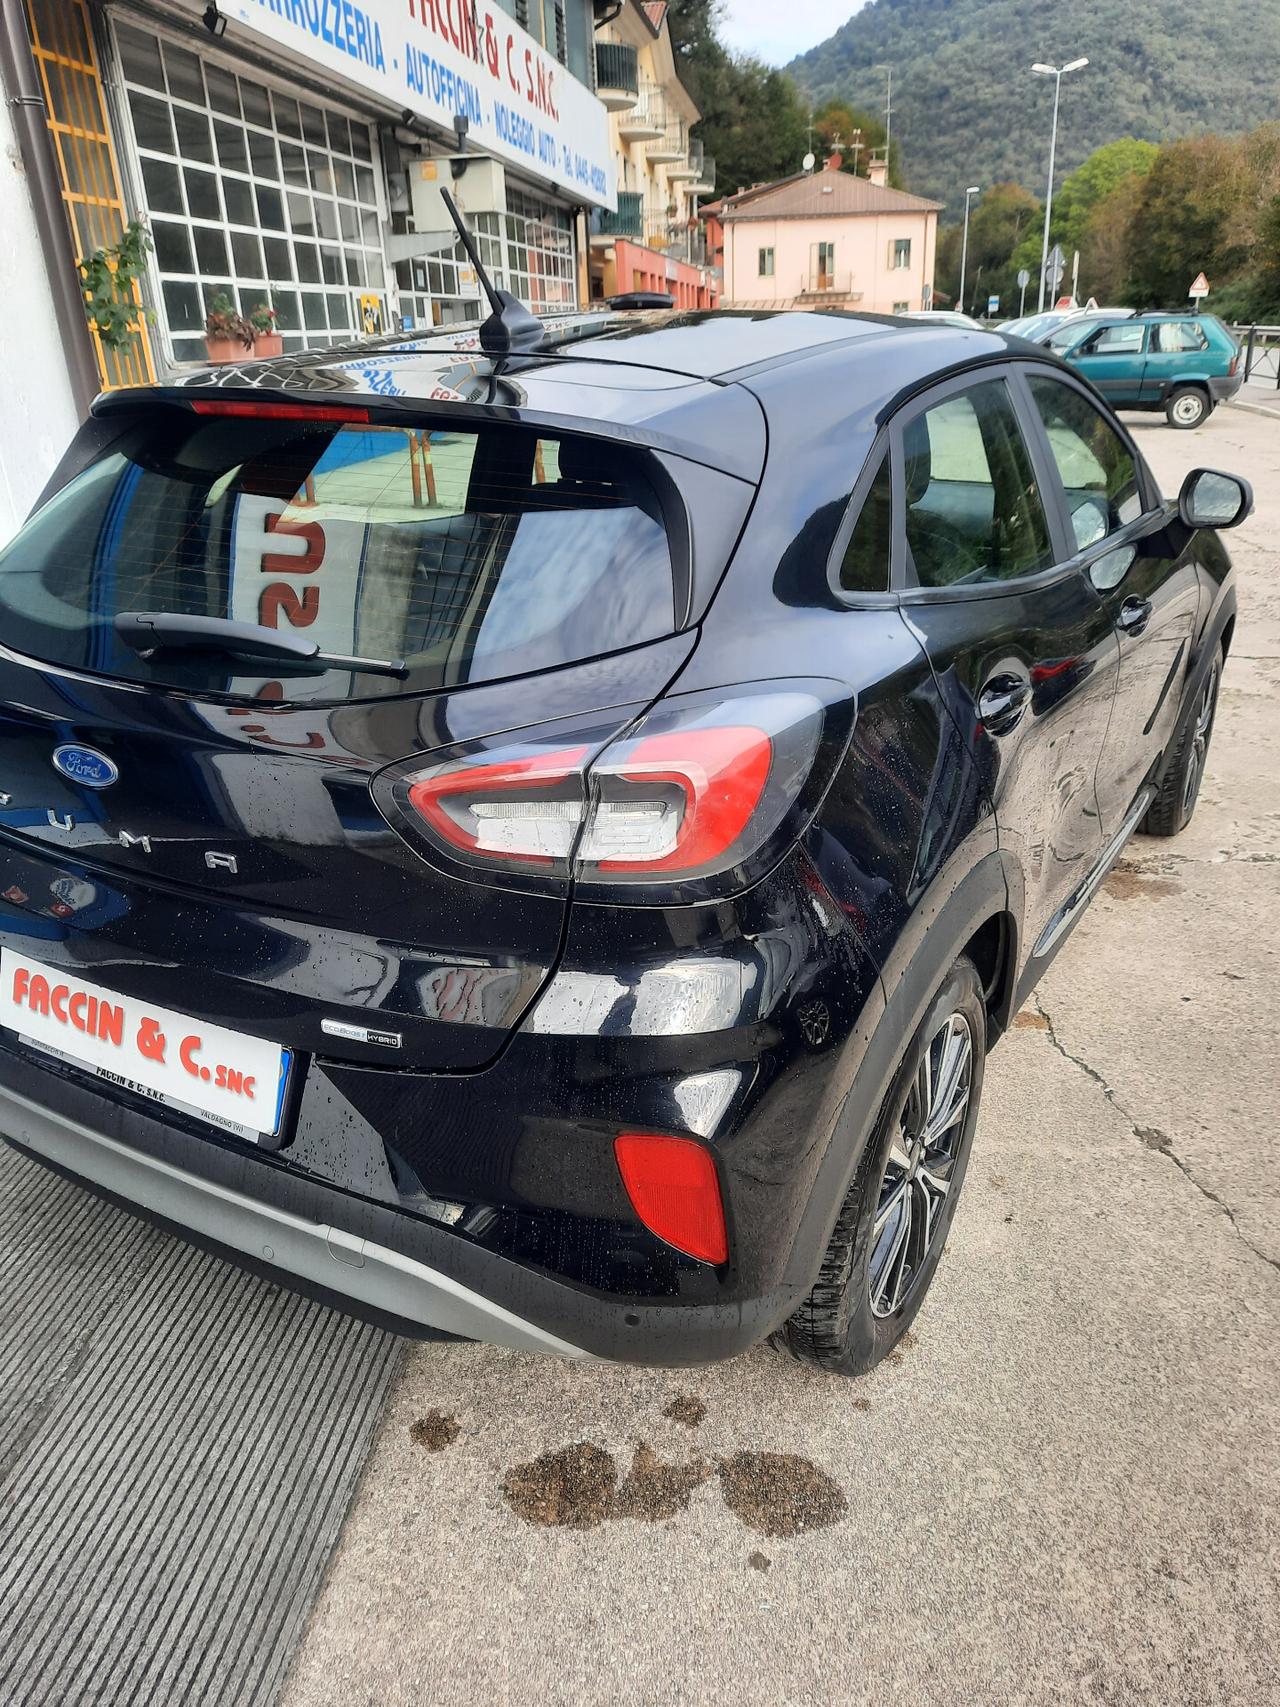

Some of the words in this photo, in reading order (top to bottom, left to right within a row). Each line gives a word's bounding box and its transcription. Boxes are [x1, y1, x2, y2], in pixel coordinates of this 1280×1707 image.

[485, 12, 501, 80] &
[406, 42, 483, 128] AUTOFFICINA
[65, 752, 101, 779] Ford
[13, 967, 124, 1047] FACCIN
[137, 1017, 166, 1064] &
[180, 1035, 211, 1081] C.
[215, 1064, 256, 1098] SNC
[367, 1034, 398, 1046] HYBRID
[96, 1066, 126, 1086] FACCIN
[127, 1079, 135, 1090] &
[200, 1108, 232, 1129] VALDAGNO
